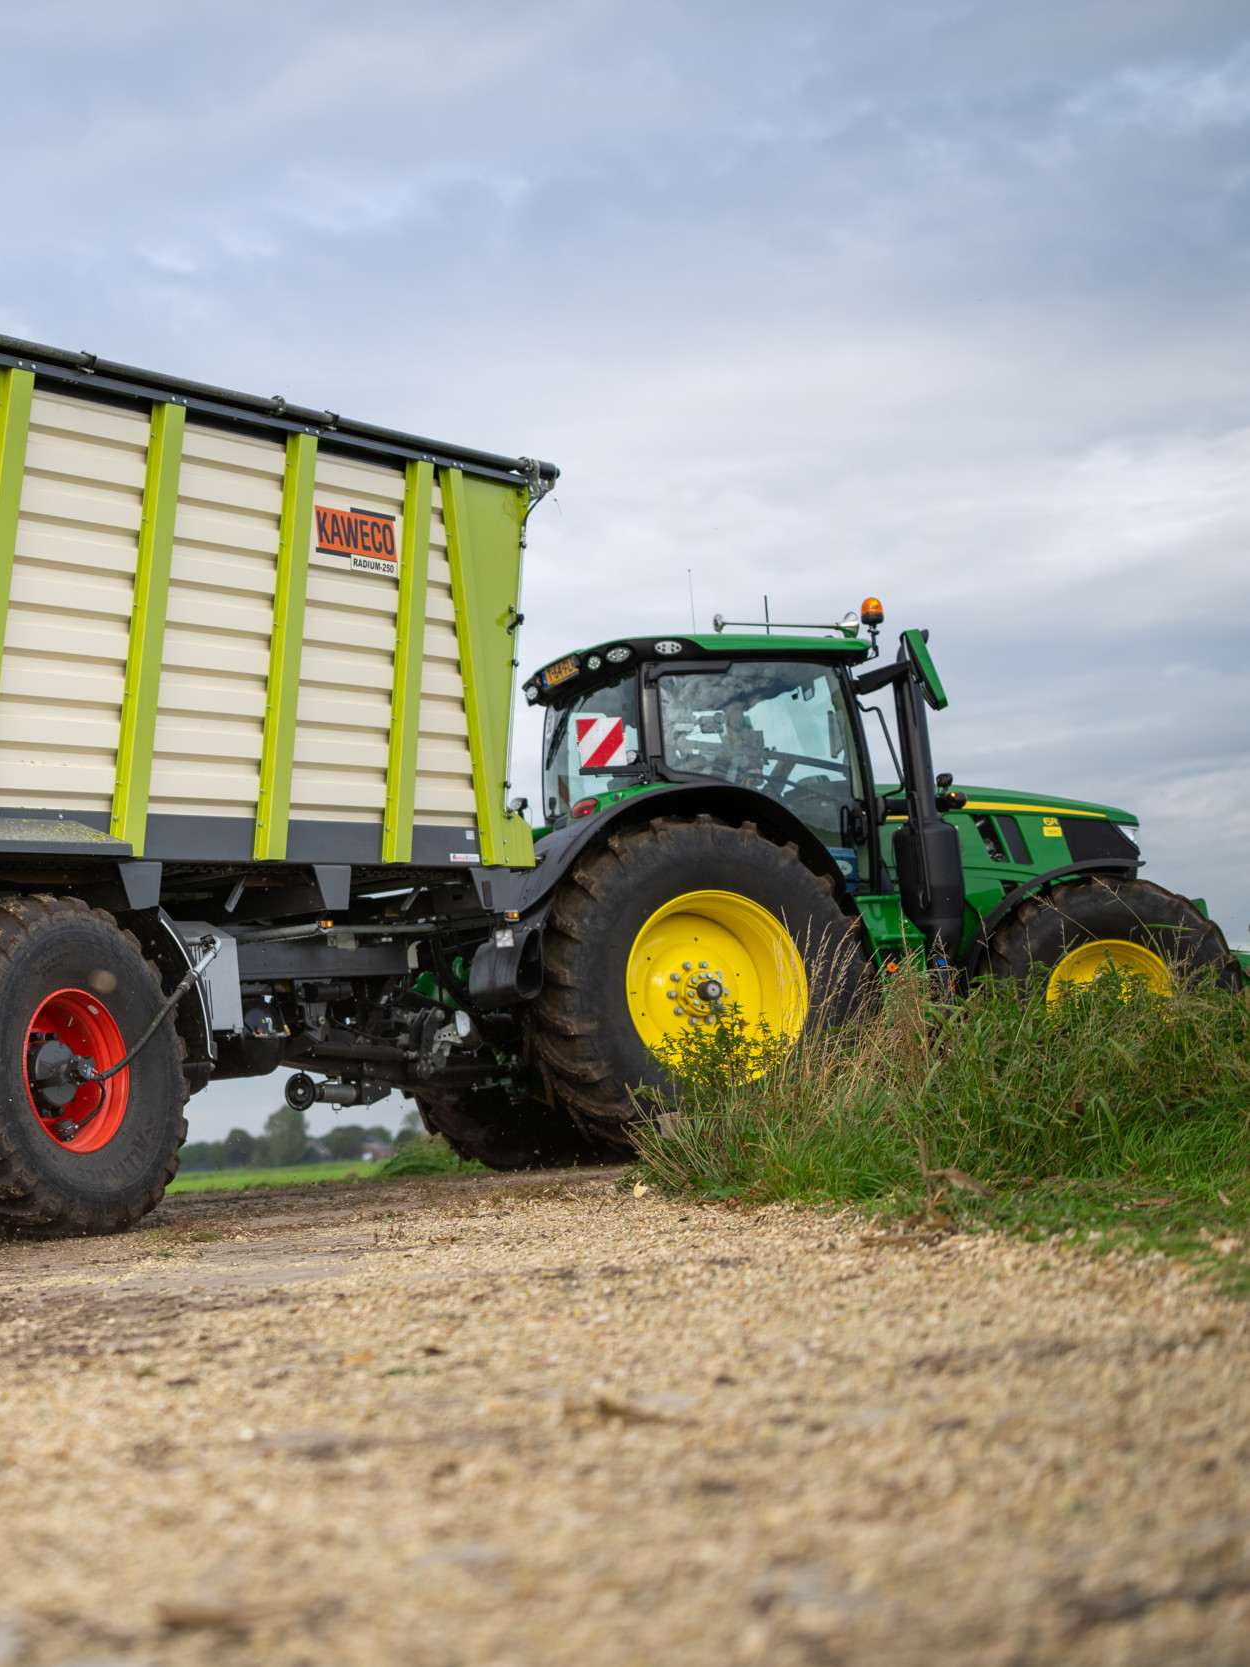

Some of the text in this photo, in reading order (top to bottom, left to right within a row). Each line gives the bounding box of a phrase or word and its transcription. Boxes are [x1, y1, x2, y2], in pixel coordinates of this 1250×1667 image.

[317, 509, 395, 555] KAWECO
[353, 558, 395, 573] RADIUM-250
[1043, 817, 1059, 826] 6R
